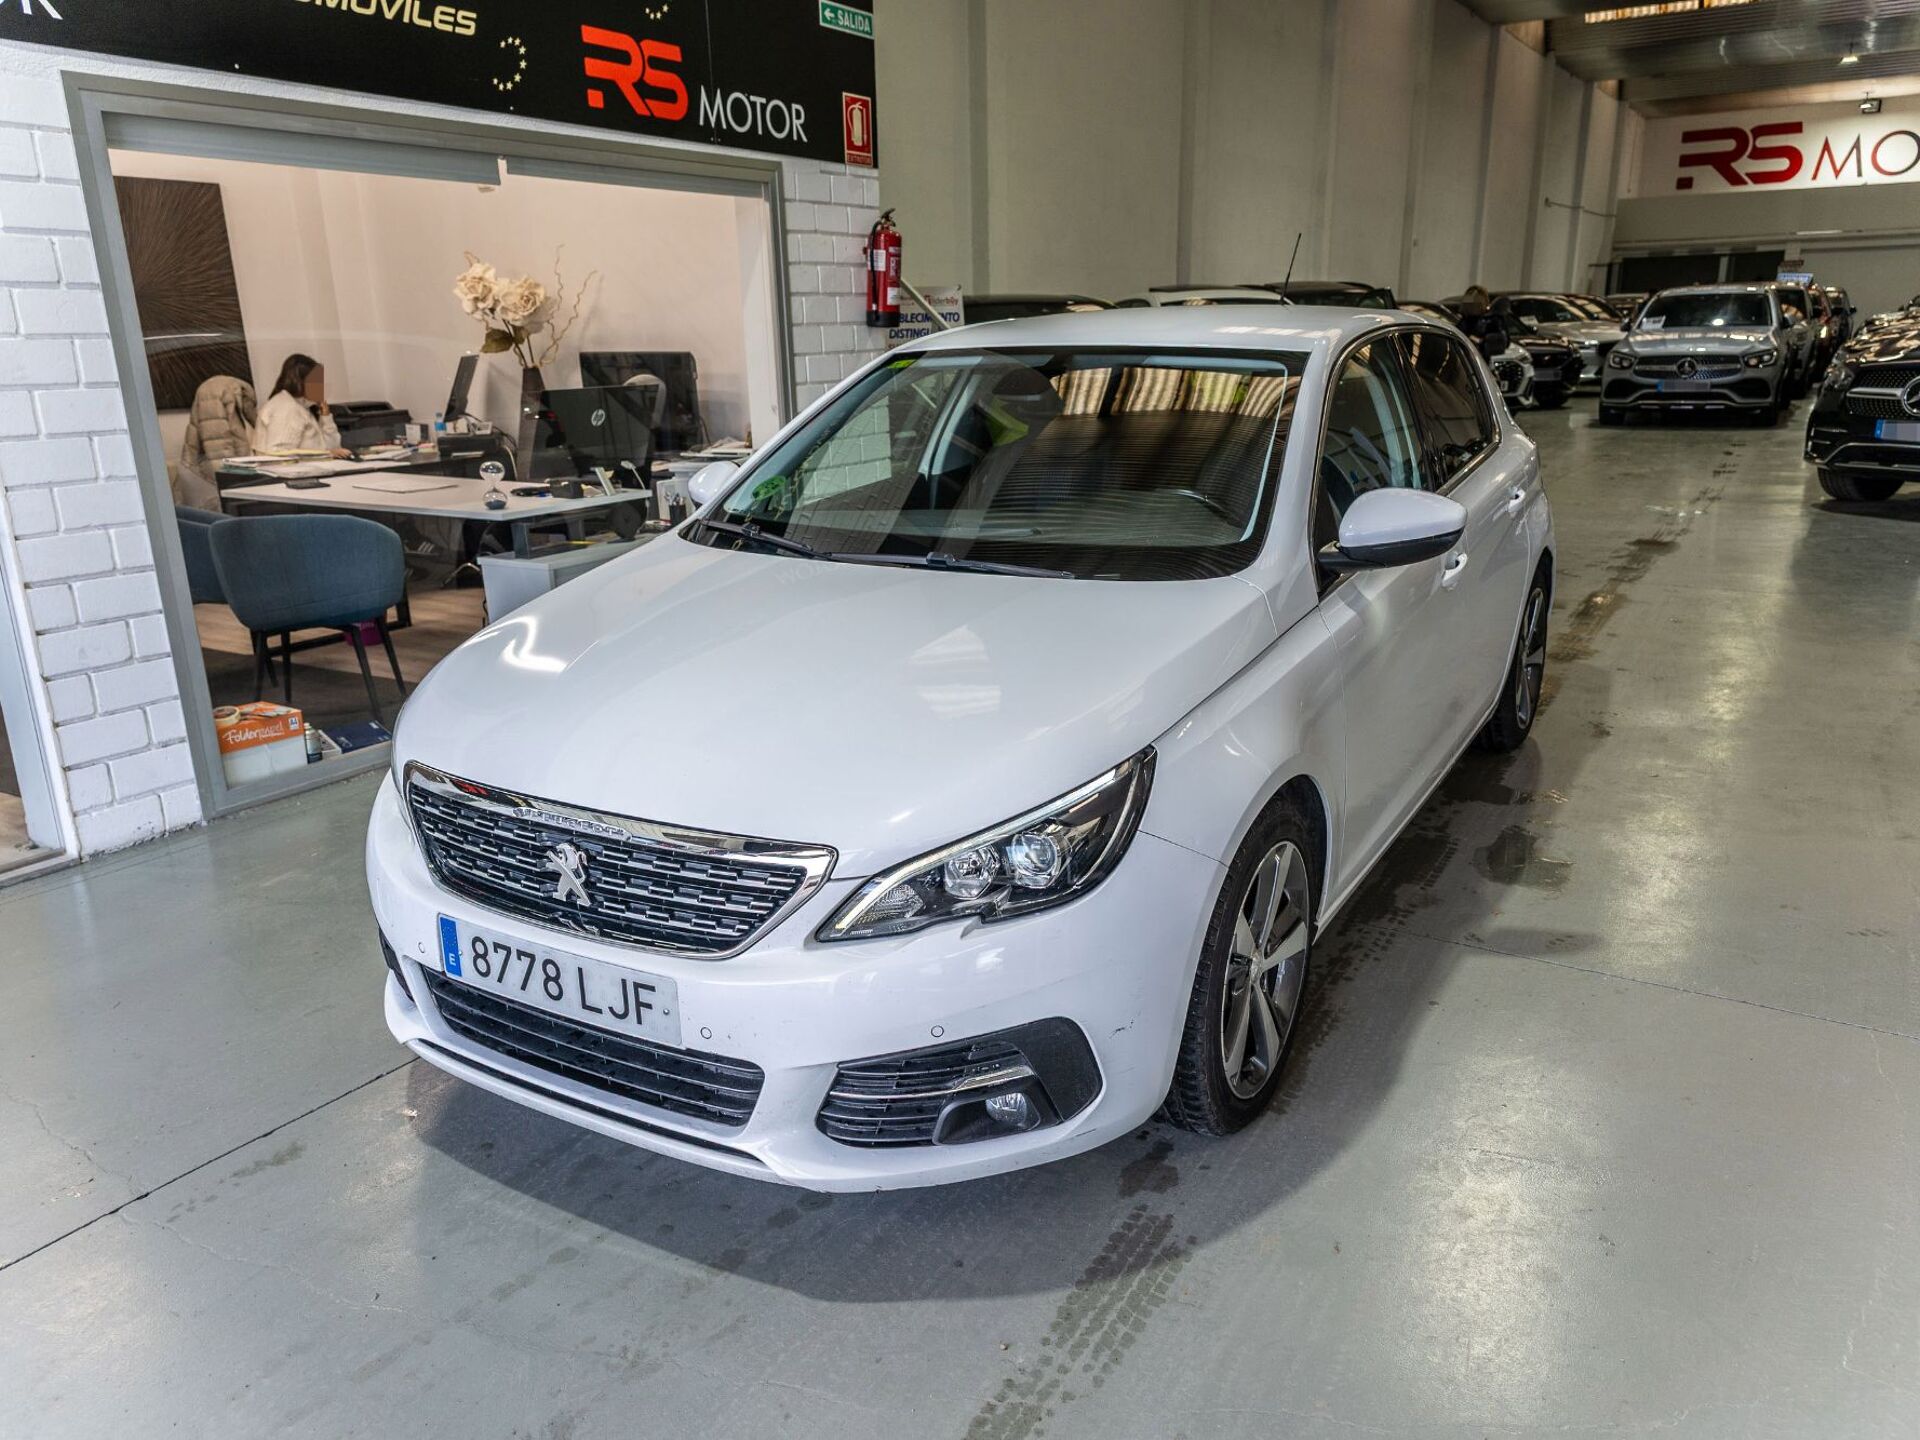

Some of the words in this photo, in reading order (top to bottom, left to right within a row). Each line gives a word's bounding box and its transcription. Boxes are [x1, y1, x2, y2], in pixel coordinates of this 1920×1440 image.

[837, 10, 871, 33] SALIDA
[581, 24, 689, 121] RS
[699, 84, 808, 143] MOTOR
[1676, 121, 1803, 190] RS
[1811, 130, 1920, 181] MO
[449, 952, 457, 966] E
[471, 936, 564, 1001] 8778
[577, 966, 656, 1025] LJF
